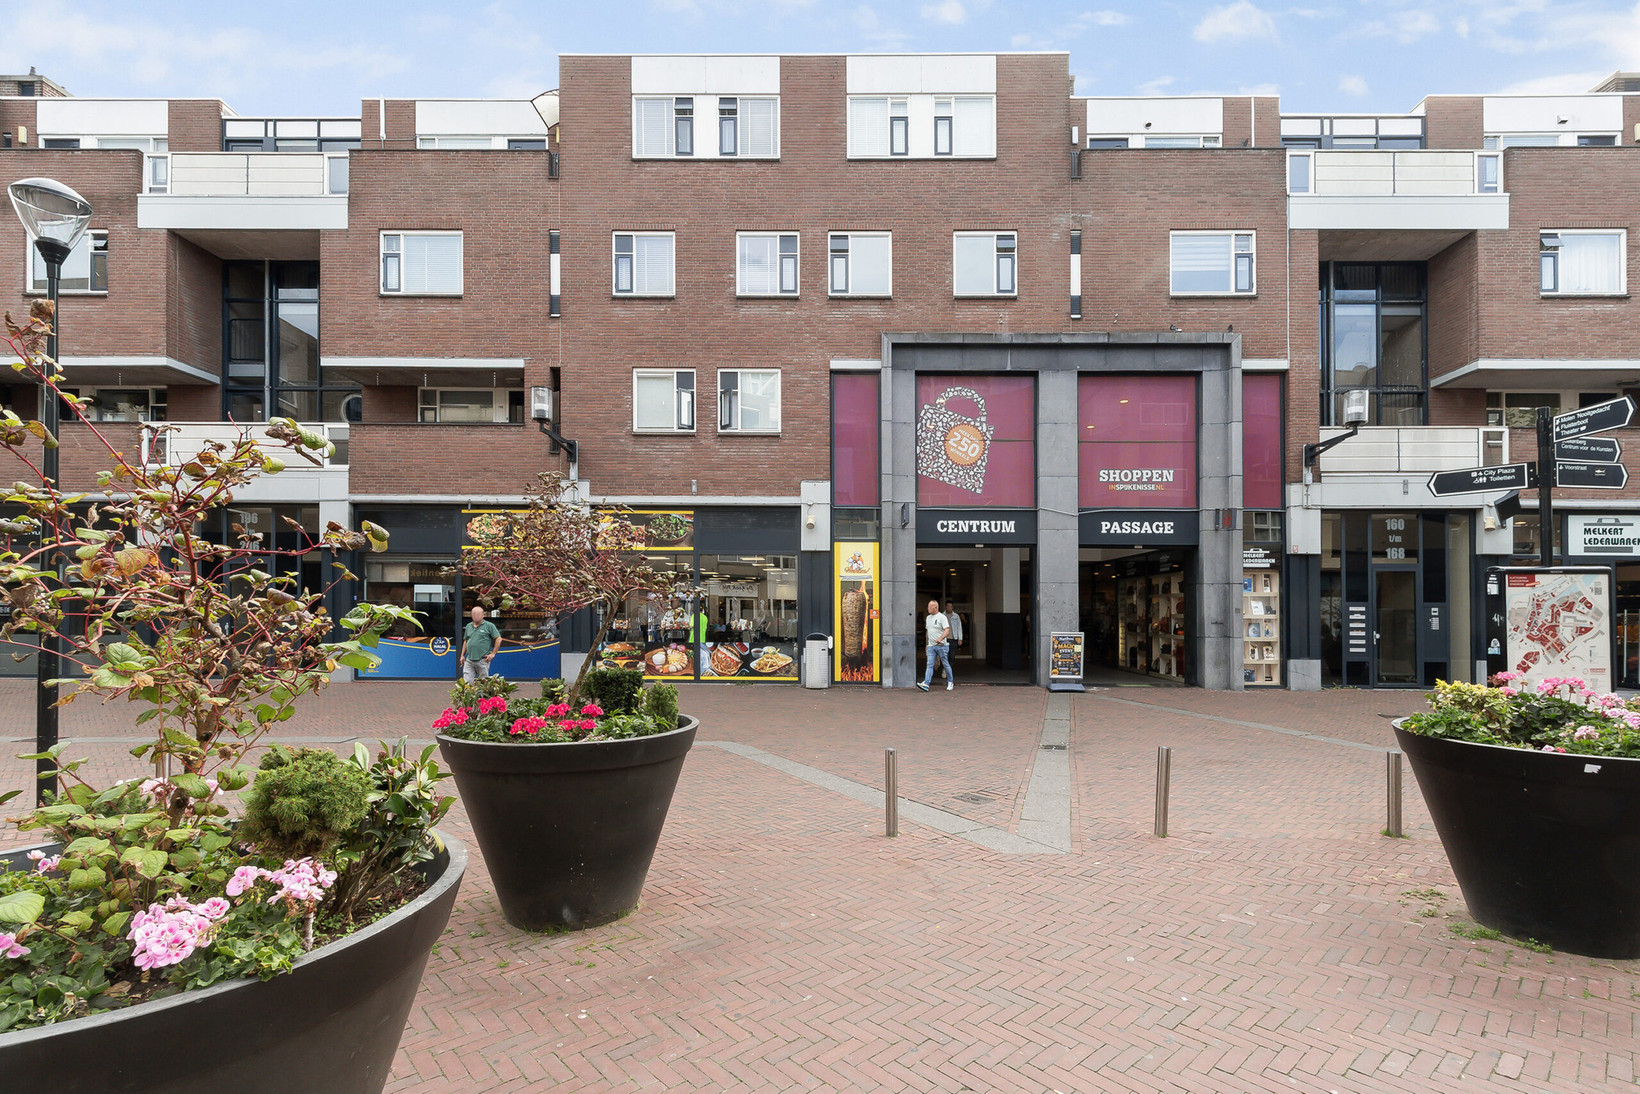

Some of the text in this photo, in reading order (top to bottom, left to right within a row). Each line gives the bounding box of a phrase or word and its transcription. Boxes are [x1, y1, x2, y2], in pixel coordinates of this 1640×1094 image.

[1560, 427, 1580, 436] Theater
[948, 431, 980, 457] 250
[1099, 469, 1174, 482] SHOPPEN
[1483, 469, 1496, 477] City
[936, 520, 1016, 533] CENTRUM
[1101, 521, 1174, 534] PASSAGE
[1385, 518, 1405, 530] 160
[1583, 527, 1624, 535] MELKERT
[1388, 534, 1402, 543] t/m
[1385, 547, 1406, 559] 168
